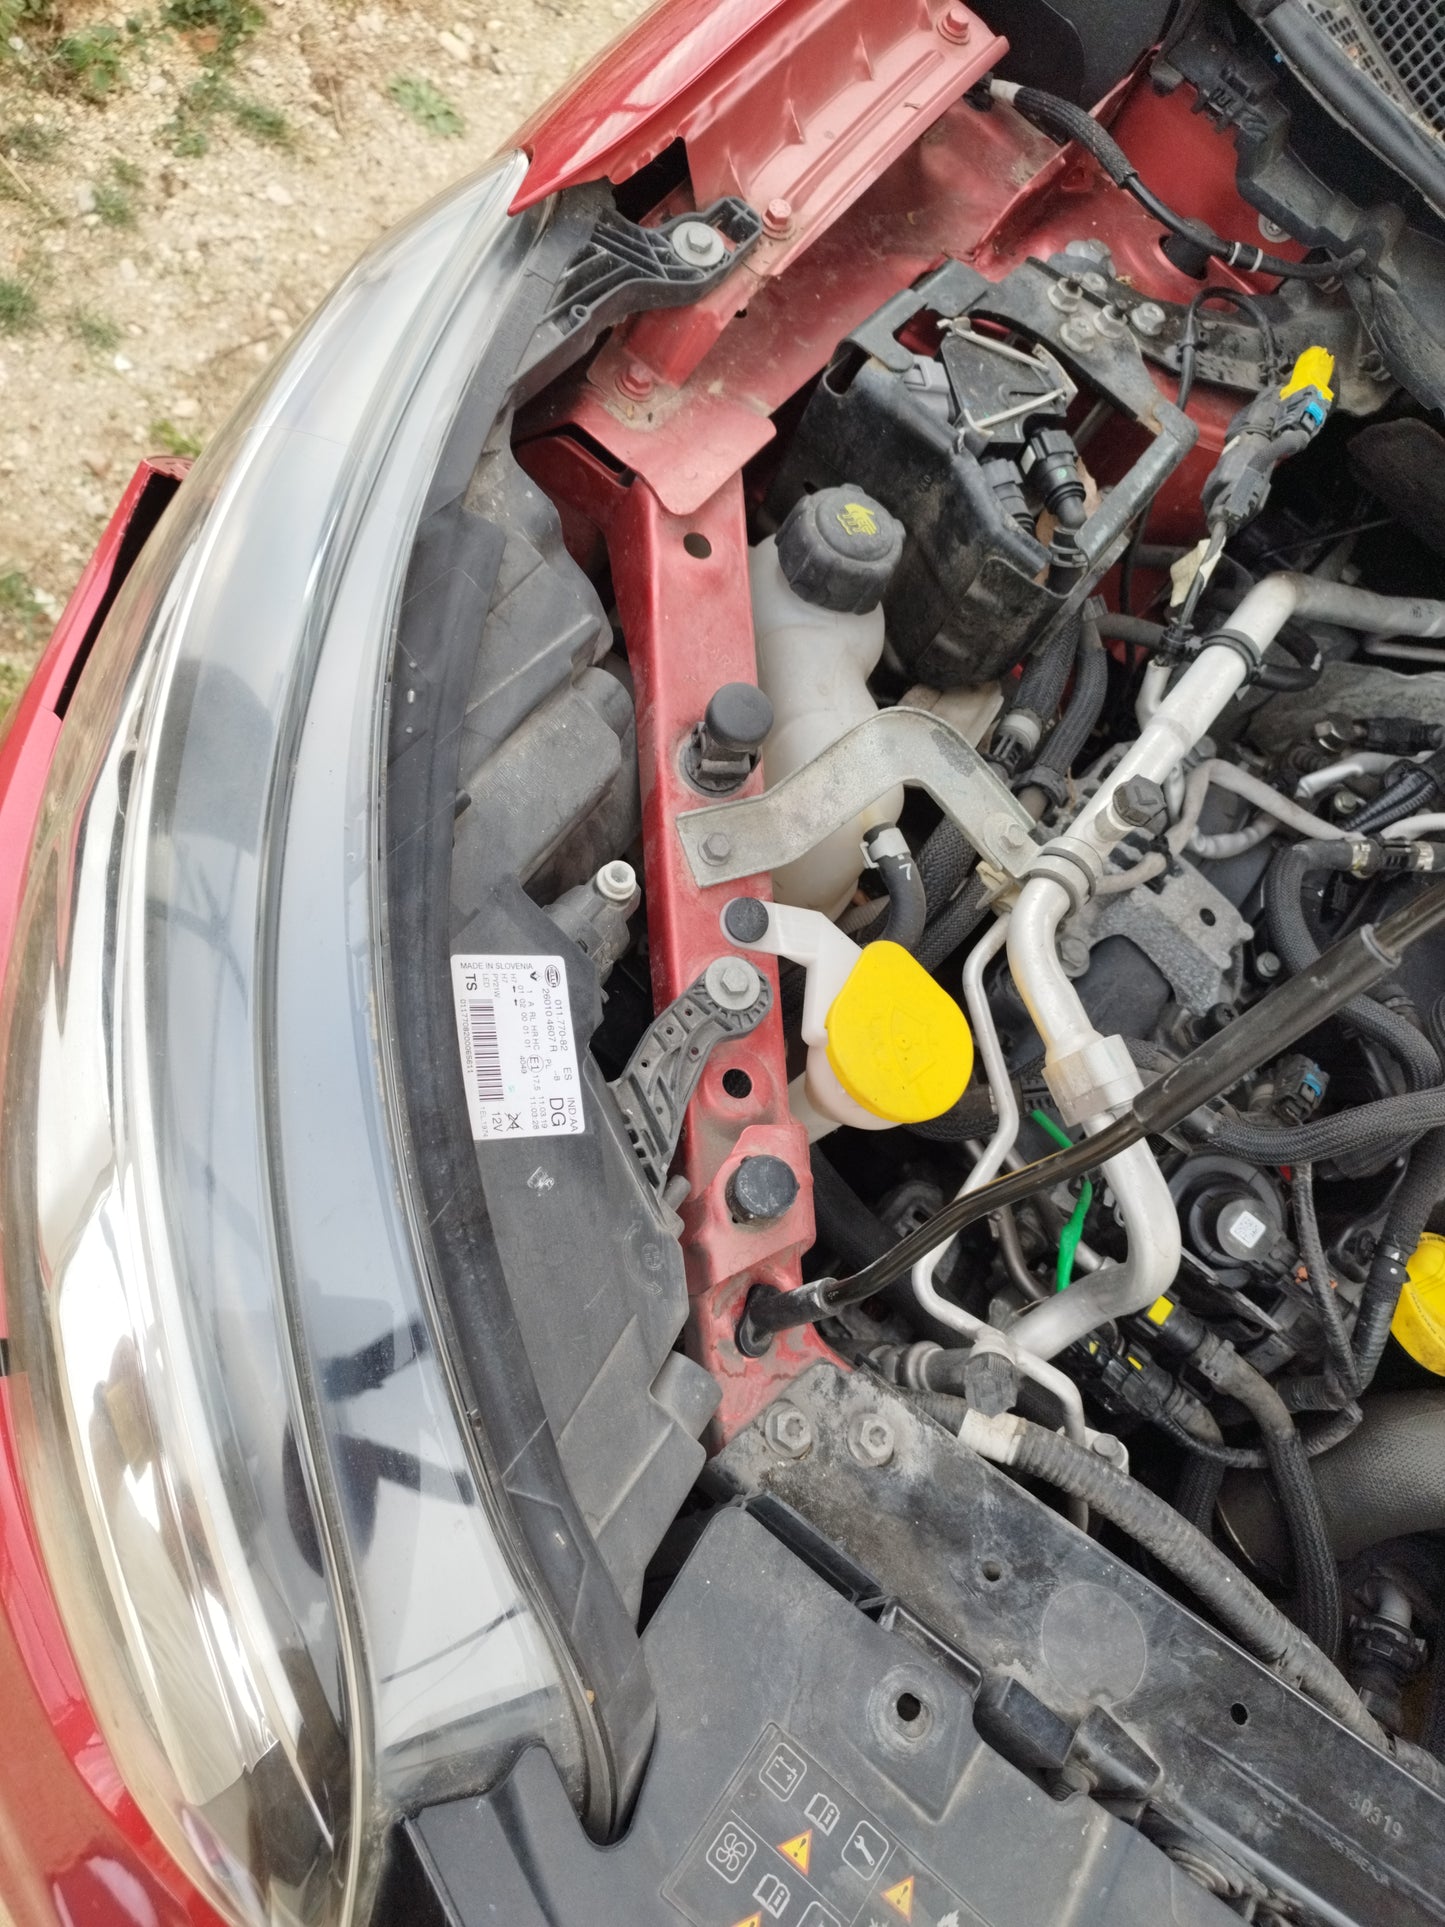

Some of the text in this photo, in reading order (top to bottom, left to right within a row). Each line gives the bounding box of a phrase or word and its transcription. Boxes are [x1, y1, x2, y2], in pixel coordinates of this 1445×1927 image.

[460, 962, 534, 970] MADE IN SLOVENIA
[465, 973, 478, 991] TS
[482, 974, 490, 988] LED
[492, 974, 501, 998] PY21W
[501, 974, 508, 983] H7
[510, 974, 517, 983] H7
[542, 988, 553, 1017] 26010
[518, 985, 531, 1048] 01 02 00 01 01
[529, 1012, 536, 1022] RL
[531, 1026, 539, 1037] HR
[547, 1019, 557, 1042] 4607
[554, 999, 568, 1051] 011.770-82
[532, 1038, 540, 1051] HC
[520, 1056, 528, 1074] 4049
[530, 1056, 539, 1071] E1
[546, 1058, 552, 1069] PL
[563, 1067, 573, 1081] ES
[549, 1097, 567, 1127] DG
[492, 1112, 503, 1132] 12V
